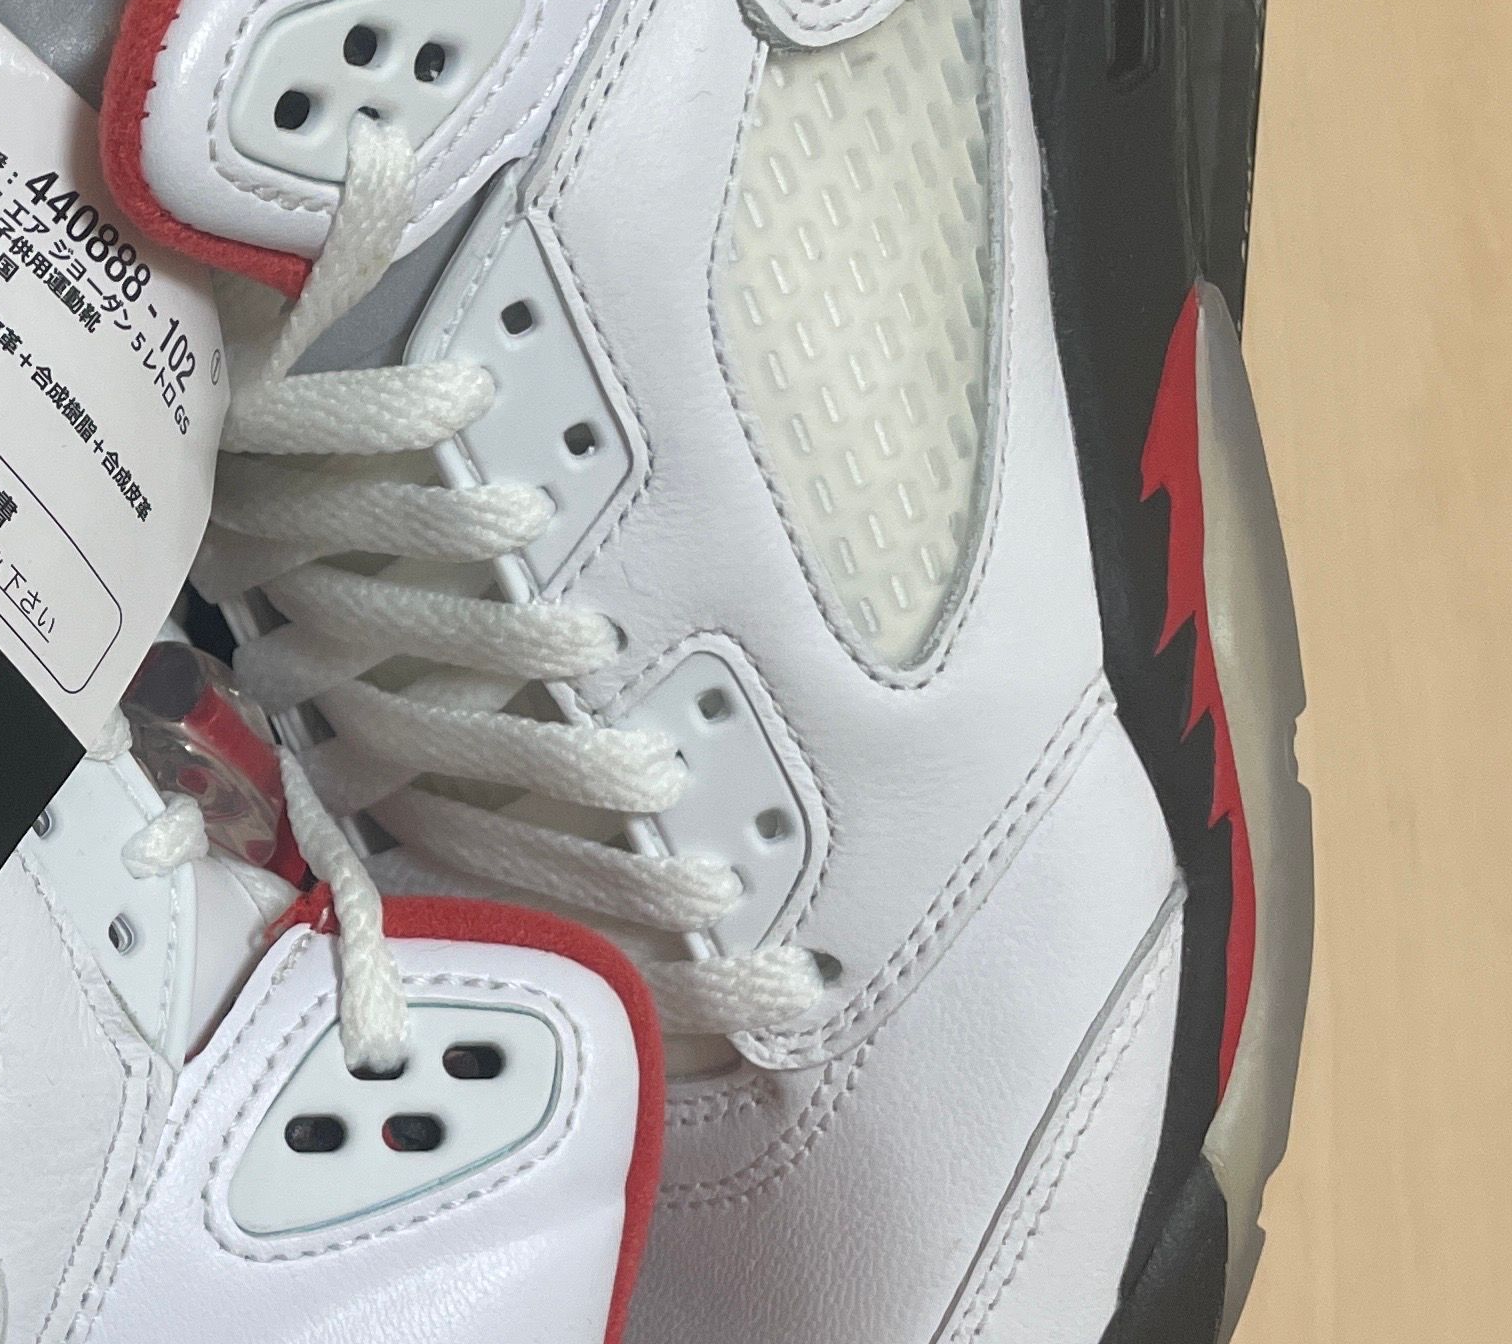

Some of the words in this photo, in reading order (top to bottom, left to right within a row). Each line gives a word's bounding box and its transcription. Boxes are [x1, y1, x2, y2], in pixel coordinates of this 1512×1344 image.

[2, 198, 50, 234] エア
[130, 331, 146, 352] 5
[142, 347, 177, 408] レトロ
[173, 404, 190, 435] GS
[24, 171, 151, 302] 440888
[160, 317, 196, 394] 102
